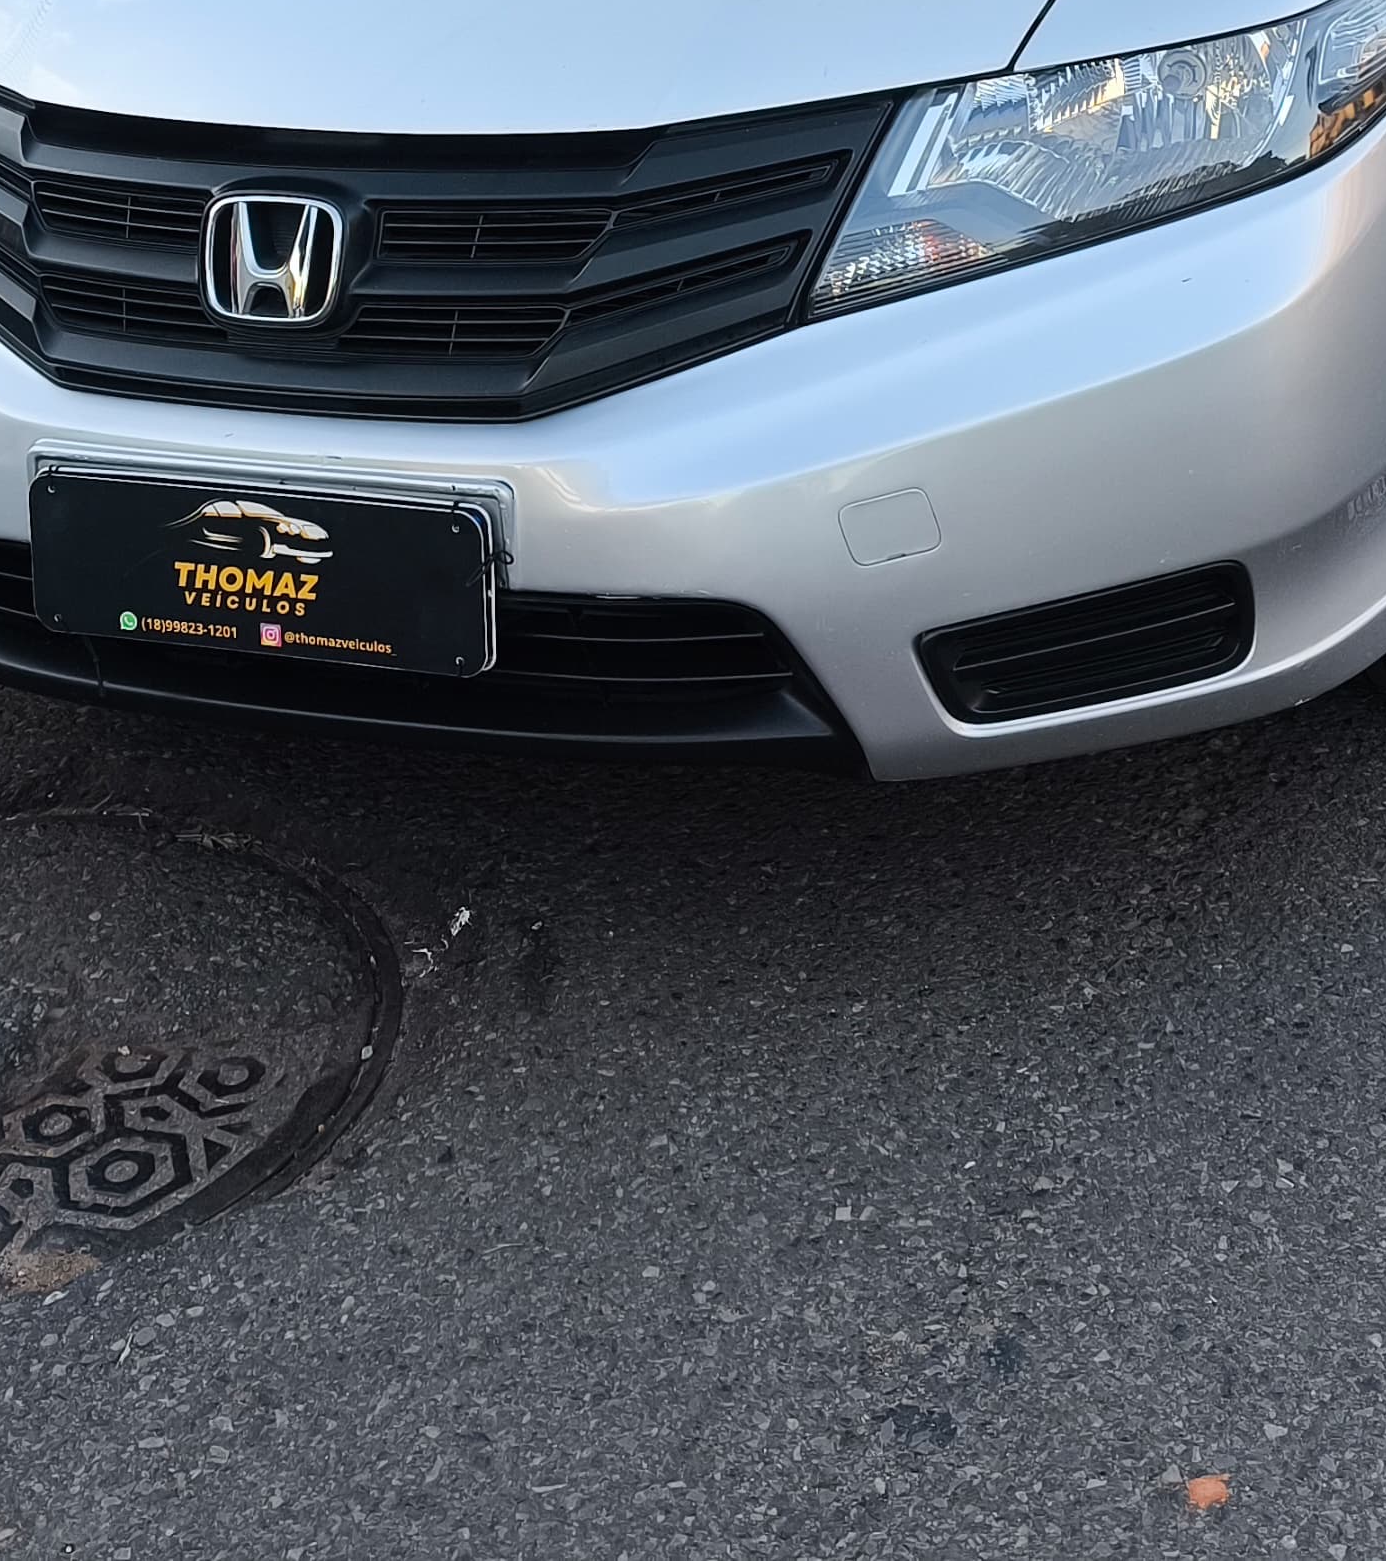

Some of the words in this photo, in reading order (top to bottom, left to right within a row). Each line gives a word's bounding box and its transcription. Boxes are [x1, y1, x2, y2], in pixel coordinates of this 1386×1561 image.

[174, 561, 319, 600] THOMAZ
[184, 591, 307, 616] VEÍCULOS
[141, 617, 238, 639] (18)99823-1201
